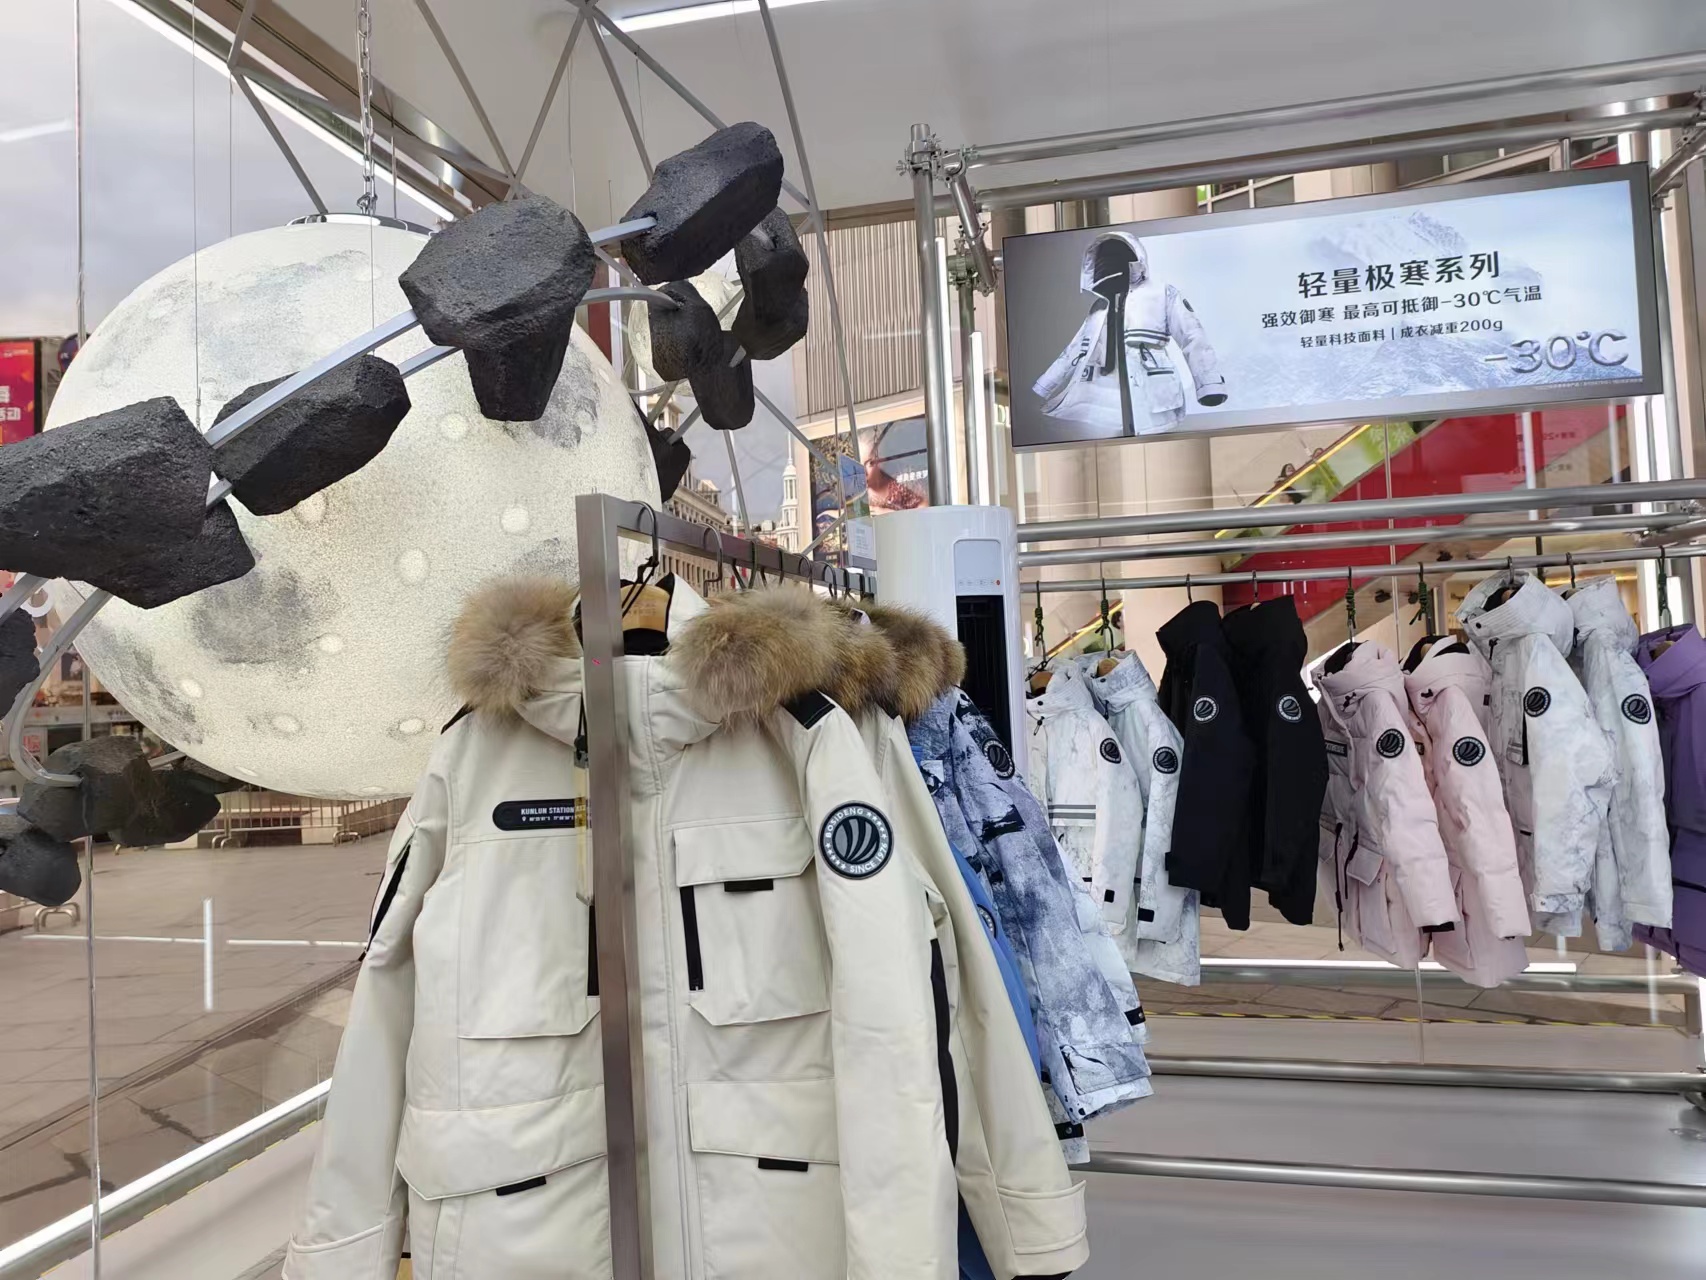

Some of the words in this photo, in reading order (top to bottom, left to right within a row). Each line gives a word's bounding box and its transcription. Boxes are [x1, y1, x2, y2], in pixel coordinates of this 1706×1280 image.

[1298, 251, 1500, 298] 轻量极寒系列
[1261, 306, 1336, 329] 强效御寒
[1300, 329, 1386, 349] 轻量科技面料
[1400, 319, 1504, 340] 成衣减重200g
[549, 806, 575, 814] STATION
[825, 807, 864, 838] BOSIDENG
[849, 861, 877, 873] SINCE
[876, 843, 888, 862] 1976
